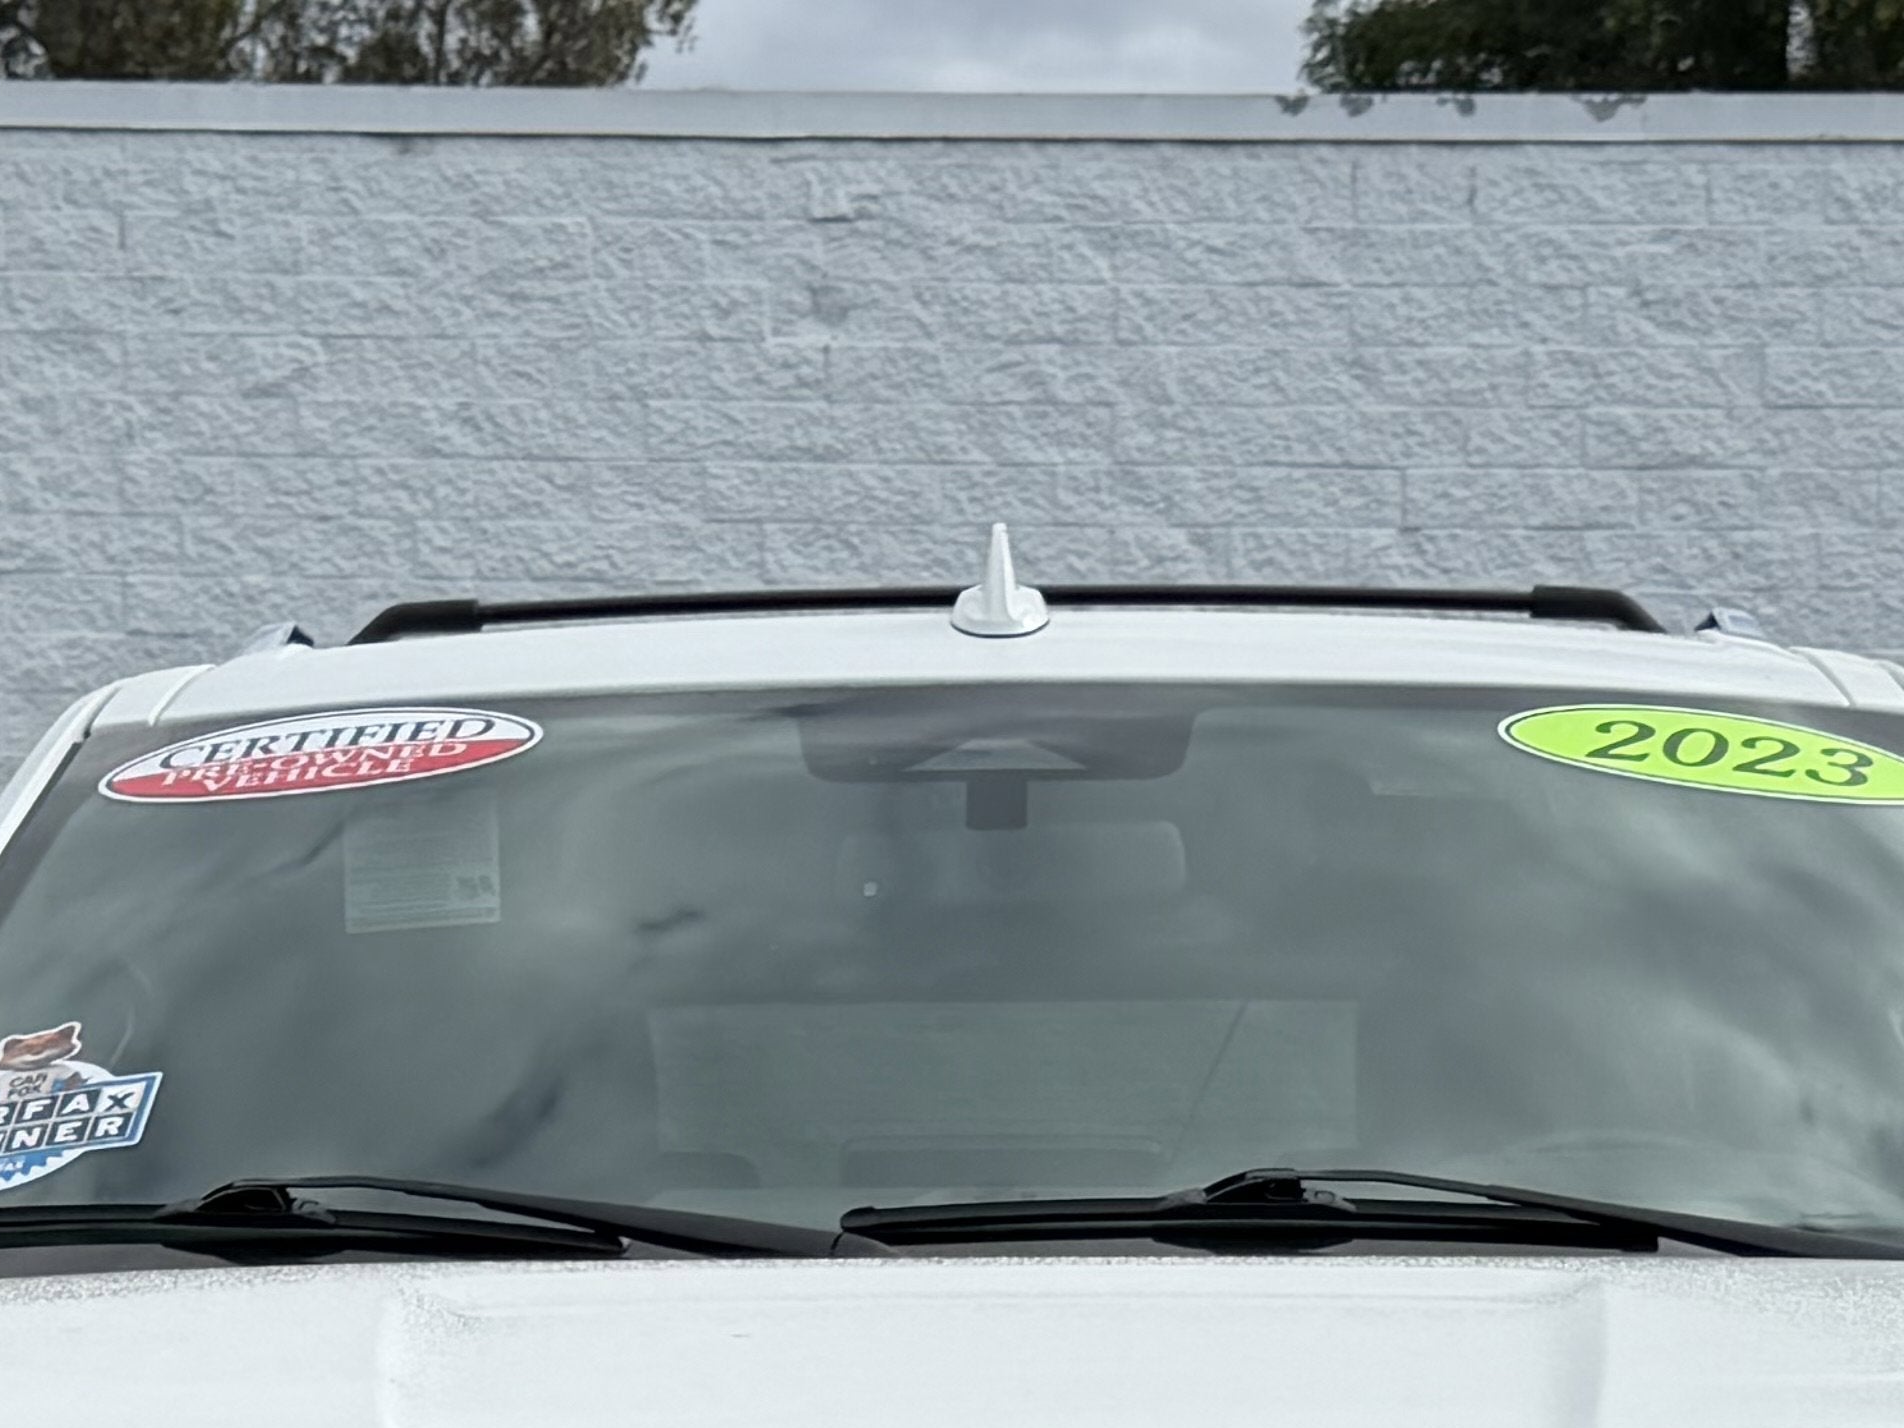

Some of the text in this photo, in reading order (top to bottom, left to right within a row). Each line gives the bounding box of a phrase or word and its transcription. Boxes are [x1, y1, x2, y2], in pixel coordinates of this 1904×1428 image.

[160, 716, 496, 769] CERTIFIED
[162, 742, 467, 787] PRE-OWNED
[1583, 719, 1875, 788] 2023
[201, 757, 417, 793] VEHICLE
[8, 1072, 48, 1088] CAR
